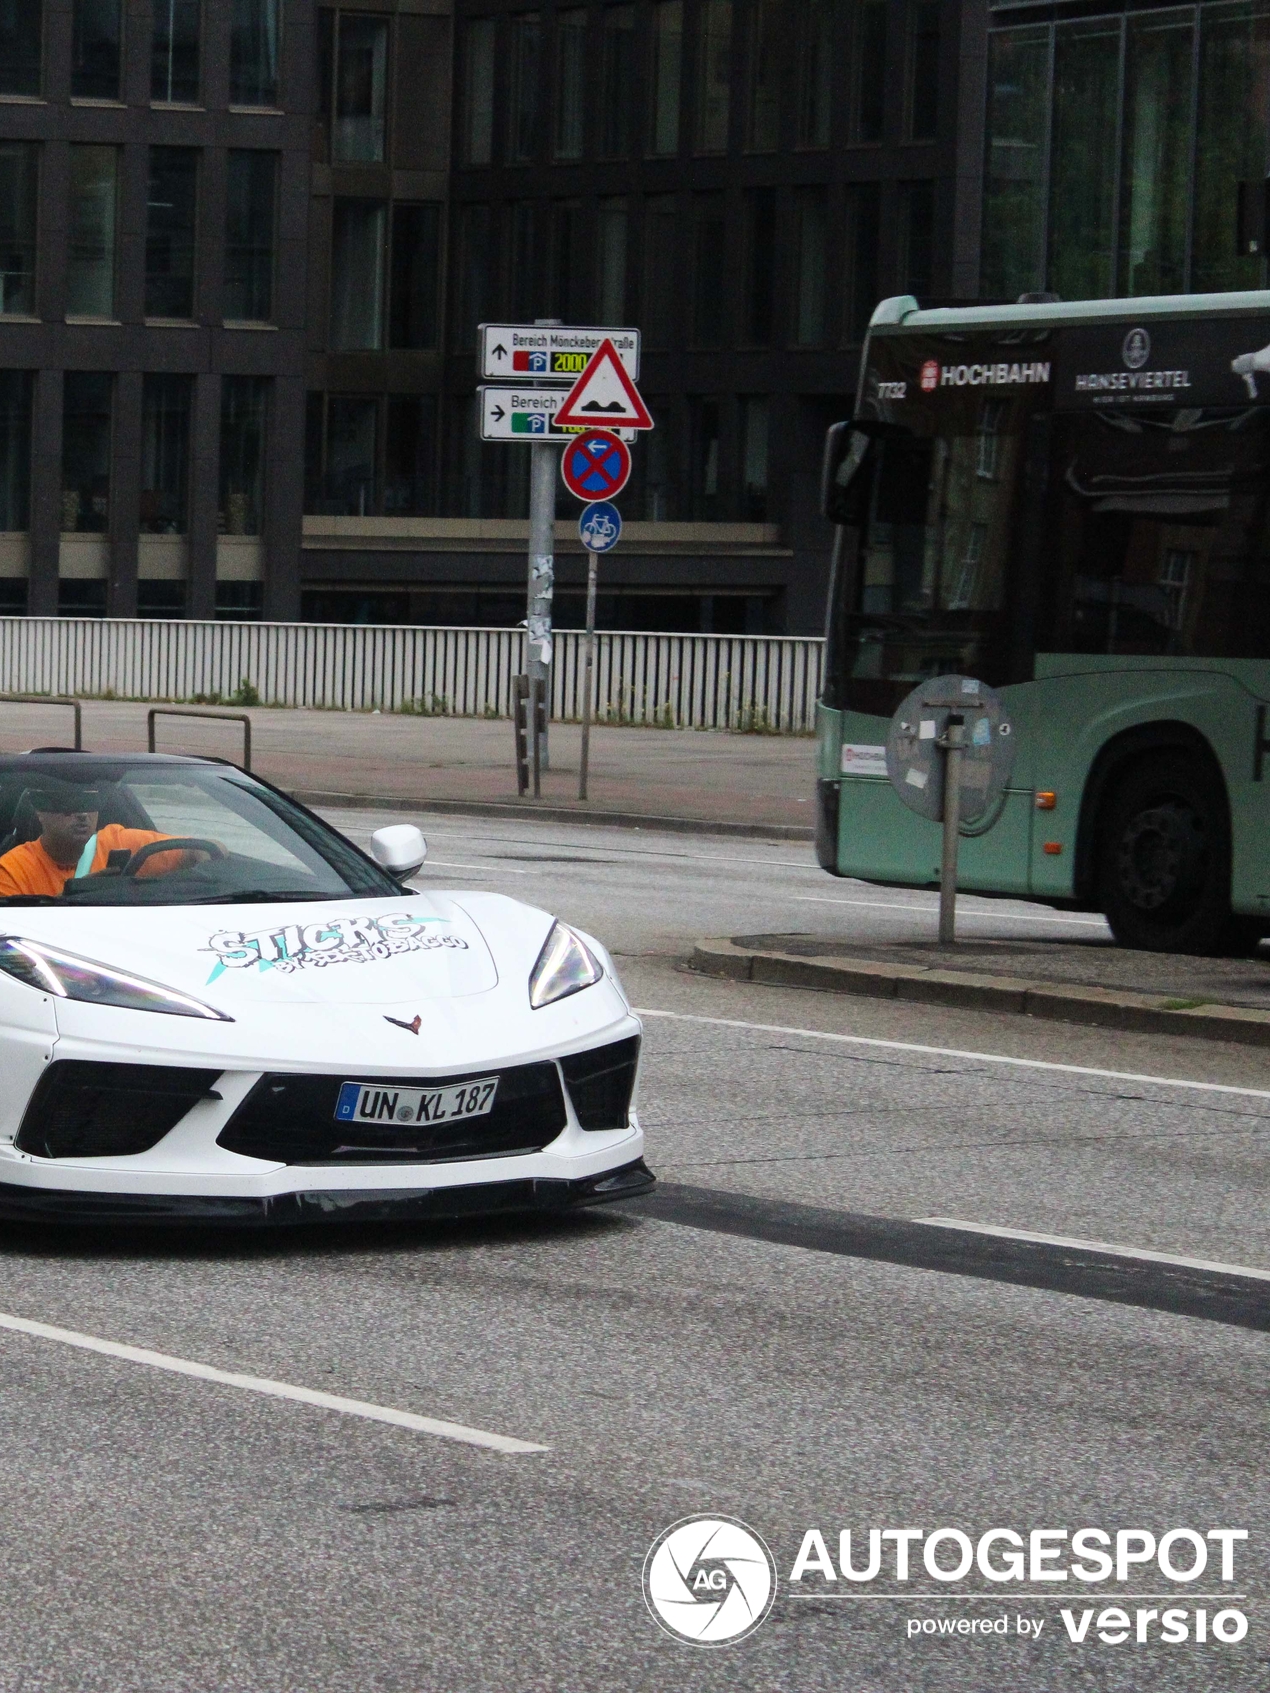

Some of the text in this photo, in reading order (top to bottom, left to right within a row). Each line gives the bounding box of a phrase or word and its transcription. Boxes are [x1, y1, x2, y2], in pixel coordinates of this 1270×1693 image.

[512, 333, 547, 347] Bereich
[554, 353, 587, 372] 2000
[941, 362, 1051, 386] HOCHBAHN
[1074, 371, 1191, 391] HANSEVIERTEL
[511, 395, 557, 409] Bereich
[208, 912, 427, 968] STICKS
[359, 1082, 496, 1122] UN KL 187
